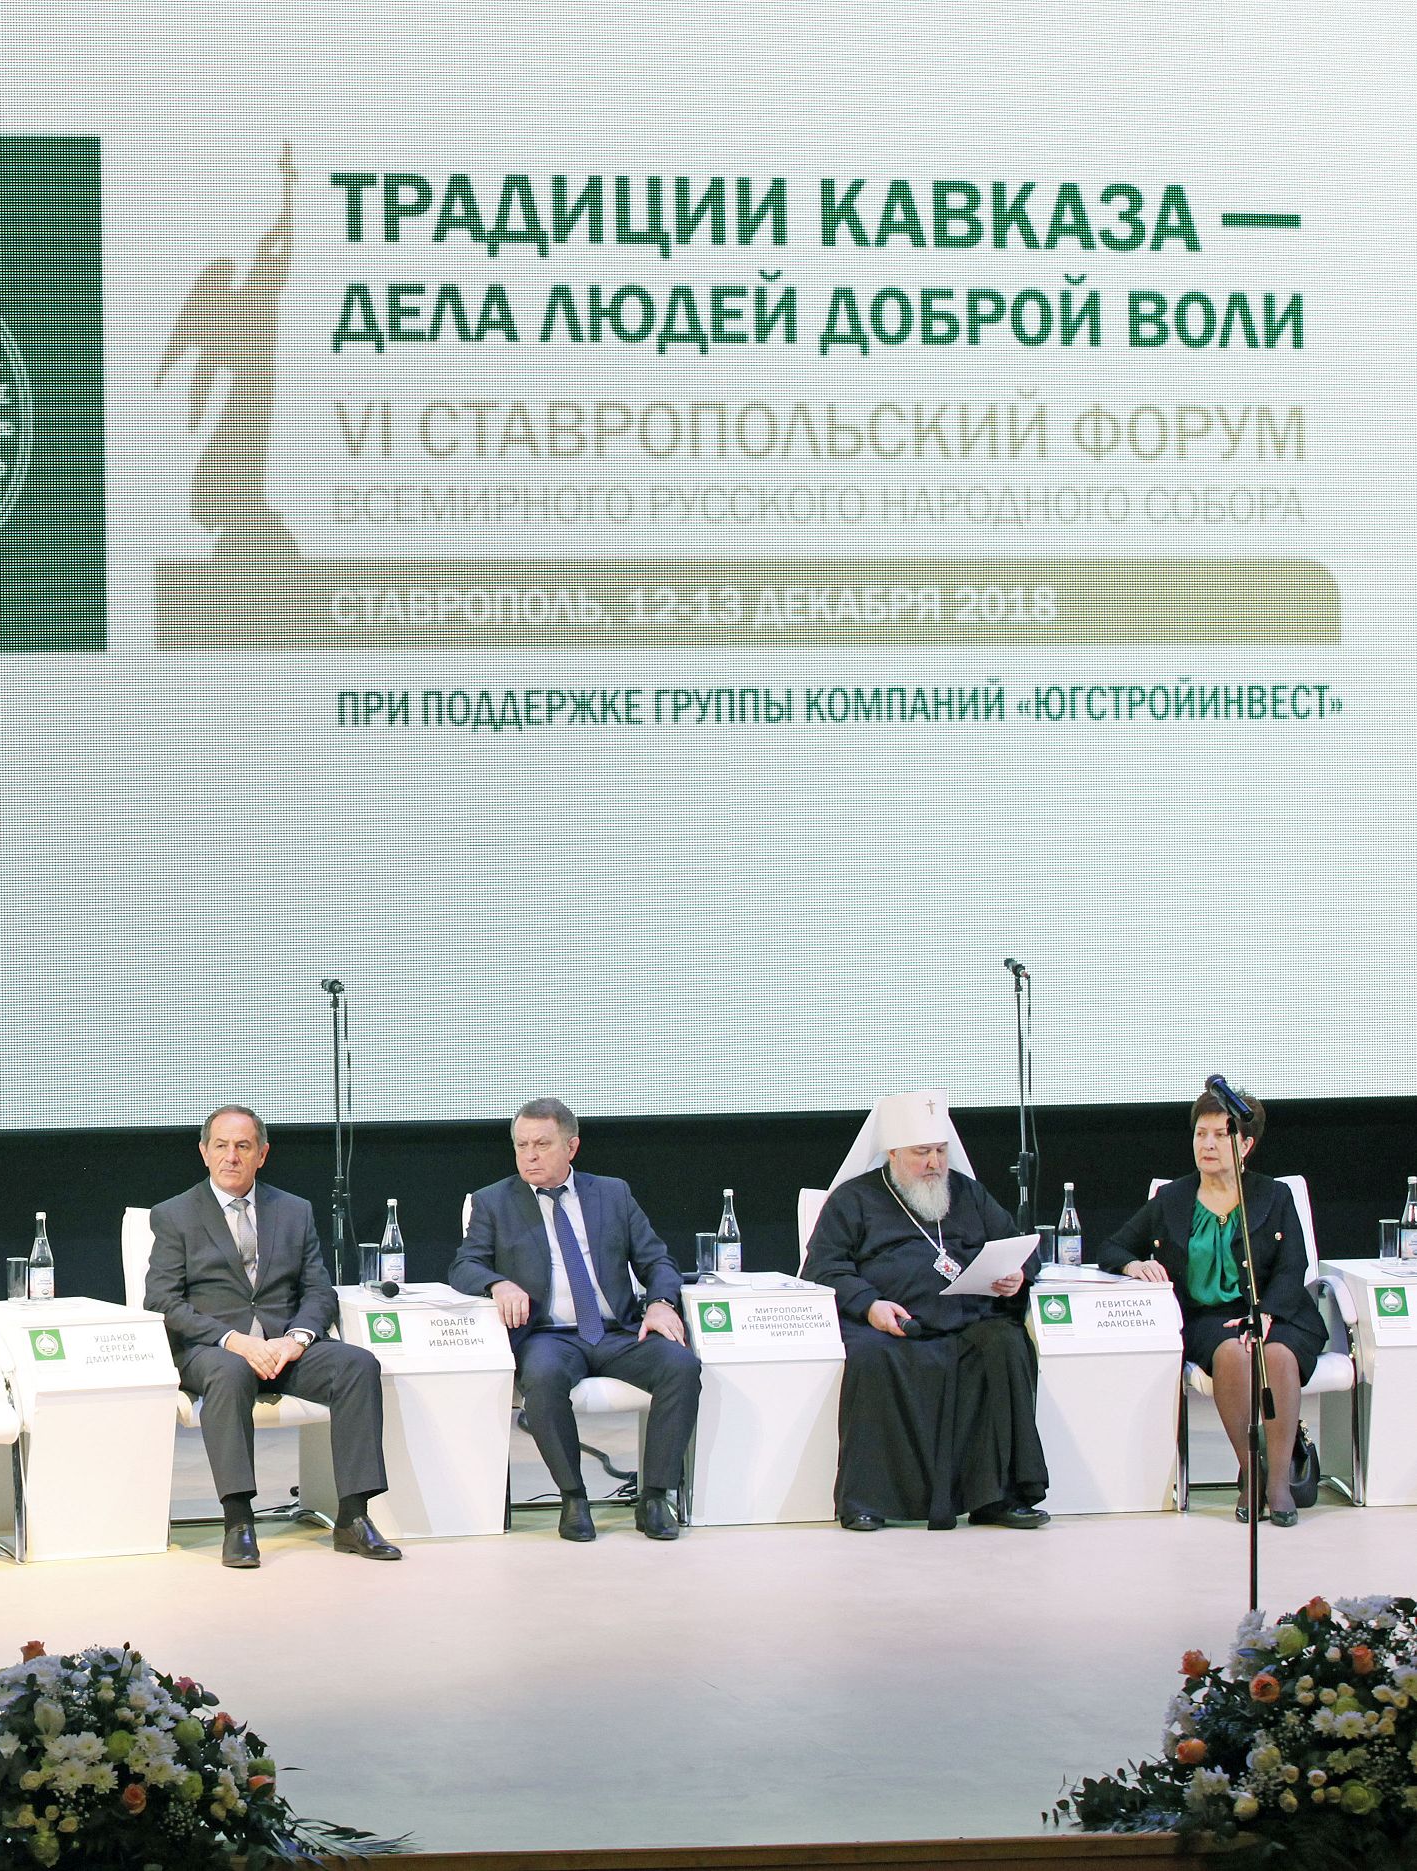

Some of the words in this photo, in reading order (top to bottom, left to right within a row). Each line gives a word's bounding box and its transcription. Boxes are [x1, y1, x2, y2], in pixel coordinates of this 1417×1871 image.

[330, 172, 788, 259] ТРАДИЦИИ
[820, 178, 1202, 253] КАВКАЗА
[332, 282, 519, 354] ДЕЛА
[539, 269, 798, 355] ЛЮДЕЙ
[819, 273, 1102, 357] ДОБРОЙ
[1128, 290, 1304, 350] ВОЛИ
[334, 400, 391, 459] VI
[418, 386, 1049, 461] СТАВРОПОЛЬСКИЙ
[1073, 402, 1306, 463] ФОРУМ
[332, 484, 636, 526] ВСЕМИРНОГО
[649, 484, 867, 526] РУССКОГО
[882, 484, 1132, 529] НАРОДНОГО
[1143, 484, 1306, 526] СОБОРА
[330, 586, 614, 630] СТАВРОПОЛЬ,
[625, 586, 743, 627] 12-13
[752, 585, 943, 630] ДЕКАБРЯ
[954, 585, 1059, 623] 2018
[336, 689, 411, 728] ПРИ
[421, 689, 644, 733] ПОДДЕРЖКЕ
[653, 687, 794, 726] ГРУППЫ
[805, 677, 1006, 724] КОМПАНИЙ
[1016, 676, 1344, 722] «ЮГСТРОЙИНВЕСТ»
[1094, 1299, 1152, 1309] ЛЕВИТСКАЯ
[755, 1306, 813, 1314] МИТРОПОЛИТ
[1107, 1309, 1143, 1318] АЛИНА
[430, 1317, 476, 1327] КОВАЛЁВ
[747, 1313, 823, 1323] СТАВРОПОЛЬСКИЙ
[1096, 1318, 1156, 1329] АФАКОЕВНА
[749, 1320, 831, 1331] НЕВИННОМЫССКИЙ
[441, 1328, 469, 1337] ИВАН
[770, 1330, 805, 1338] КИРИЛЛ
[93, 1333, 137, 1344] УШАКОВ
[429, 1338, 485, 1348] ИВАНОВИЧ
[99, 1343, 135, 1353] СЕРГЕЙ
[85, 1352, 155, 1365] ДМИТРИЕВИЧ
